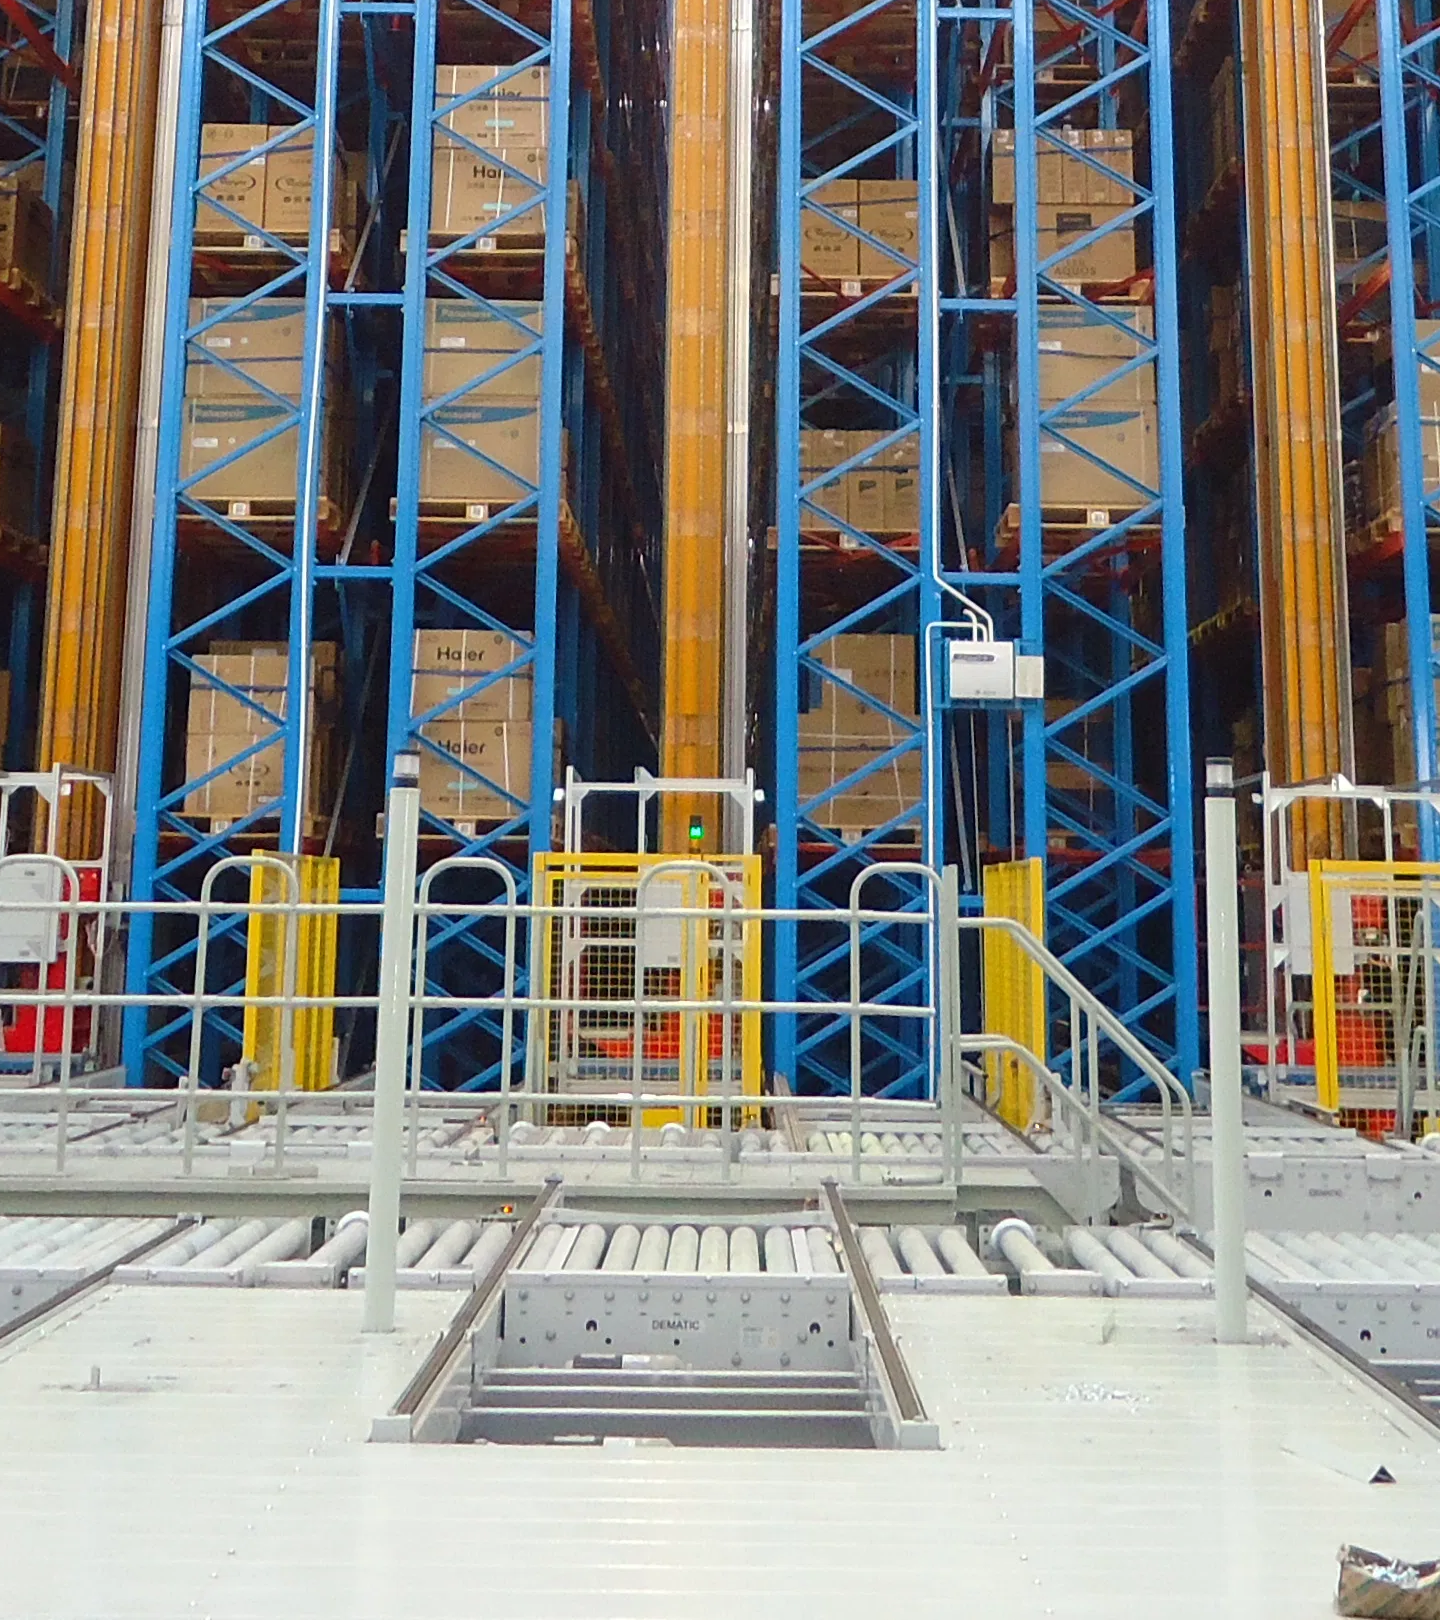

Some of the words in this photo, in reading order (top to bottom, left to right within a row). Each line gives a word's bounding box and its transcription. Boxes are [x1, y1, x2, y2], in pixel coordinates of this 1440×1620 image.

[436, 646, 485, 661] Haier
[436, 739, 486, 756] Haier
[651, 1319, 700, 1331] DEMATIC
